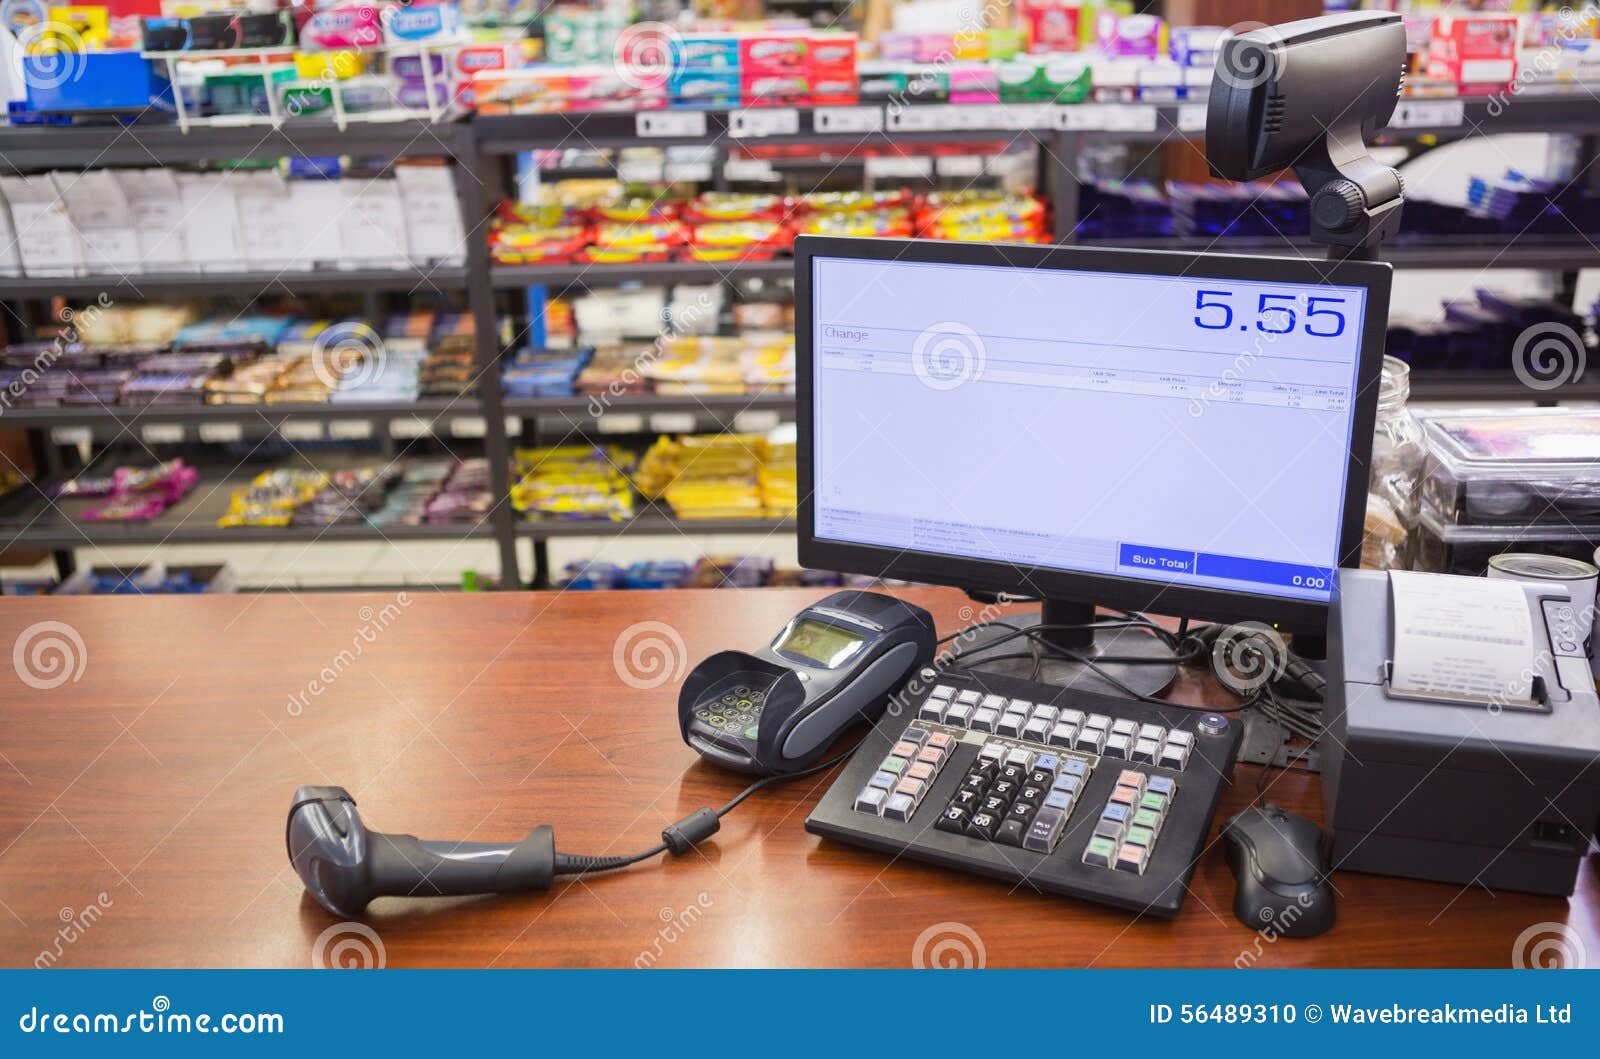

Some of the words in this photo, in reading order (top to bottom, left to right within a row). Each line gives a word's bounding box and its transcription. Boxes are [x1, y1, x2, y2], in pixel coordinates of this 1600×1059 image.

[1194, 289, 1346, 337] 5.55
[824, 326, 869, 342] Change
[1132, 554, 1156, 566] Sub
[1159, 557, 1188, 570] Total
[1292, 575, 1325, 589] 0.00
[1005, 768, 1016, 777] 8
[1034, 773, 1044, 782] 9
[969, 778, 979, 787] 4
[996, 783, 1007, 792] 5
[1024, 789, 1035, 798] 6
[986, 801, 997, 809] 2
[1015, 806, 1026, 815] 3
[949, 811, 960, 819] 0
[975, 818, 990, 827] 00
